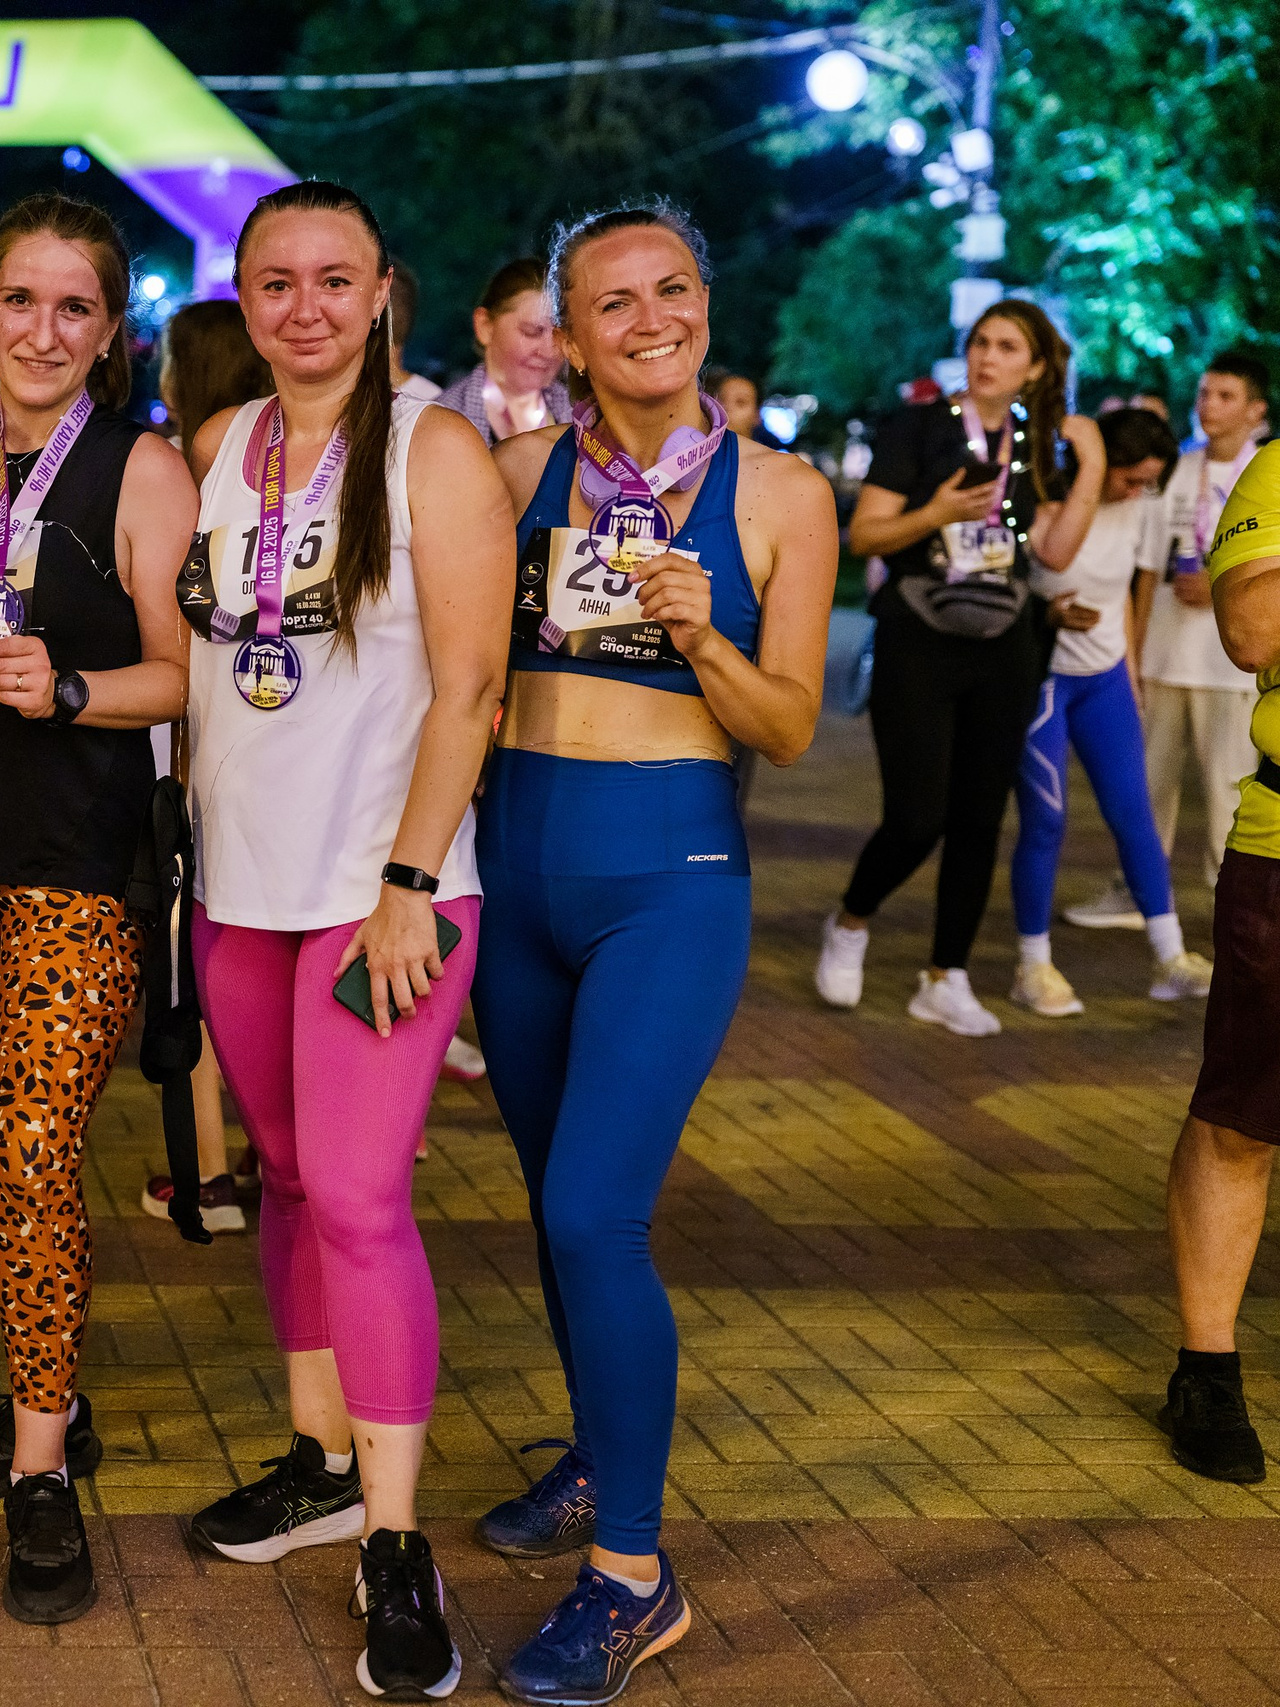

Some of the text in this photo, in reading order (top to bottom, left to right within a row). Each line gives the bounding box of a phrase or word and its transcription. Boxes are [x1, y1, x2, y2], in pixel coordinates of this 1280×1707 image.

[30, 392, 94, 492] ЗАБЕГ КАЛУГА НОЧЬ
[594, 447, 614, 468] ТВОЯ
[677, 449, 698, 471] НОЧЬ
[265, 479, 279, 513] ТВОЯ
[304, 474, 331, 506] НОЧЬ
[241, 520, 325, 574] 15
[260, 516, 278, 586] 16.08.2025
[566, 538, 642, 599] 25
[242, 580, 256, 595] ОЛ
[578, 598, 610, 616] АННА
[309, 614, 323, 623] 40
[601, 635, 617, 643] PRO
[632, 633, 661, 644] 16.08.2025
[600, 642, 658, 657] СПОРТ 40
[687, 854, 728, 862] KICKERS
